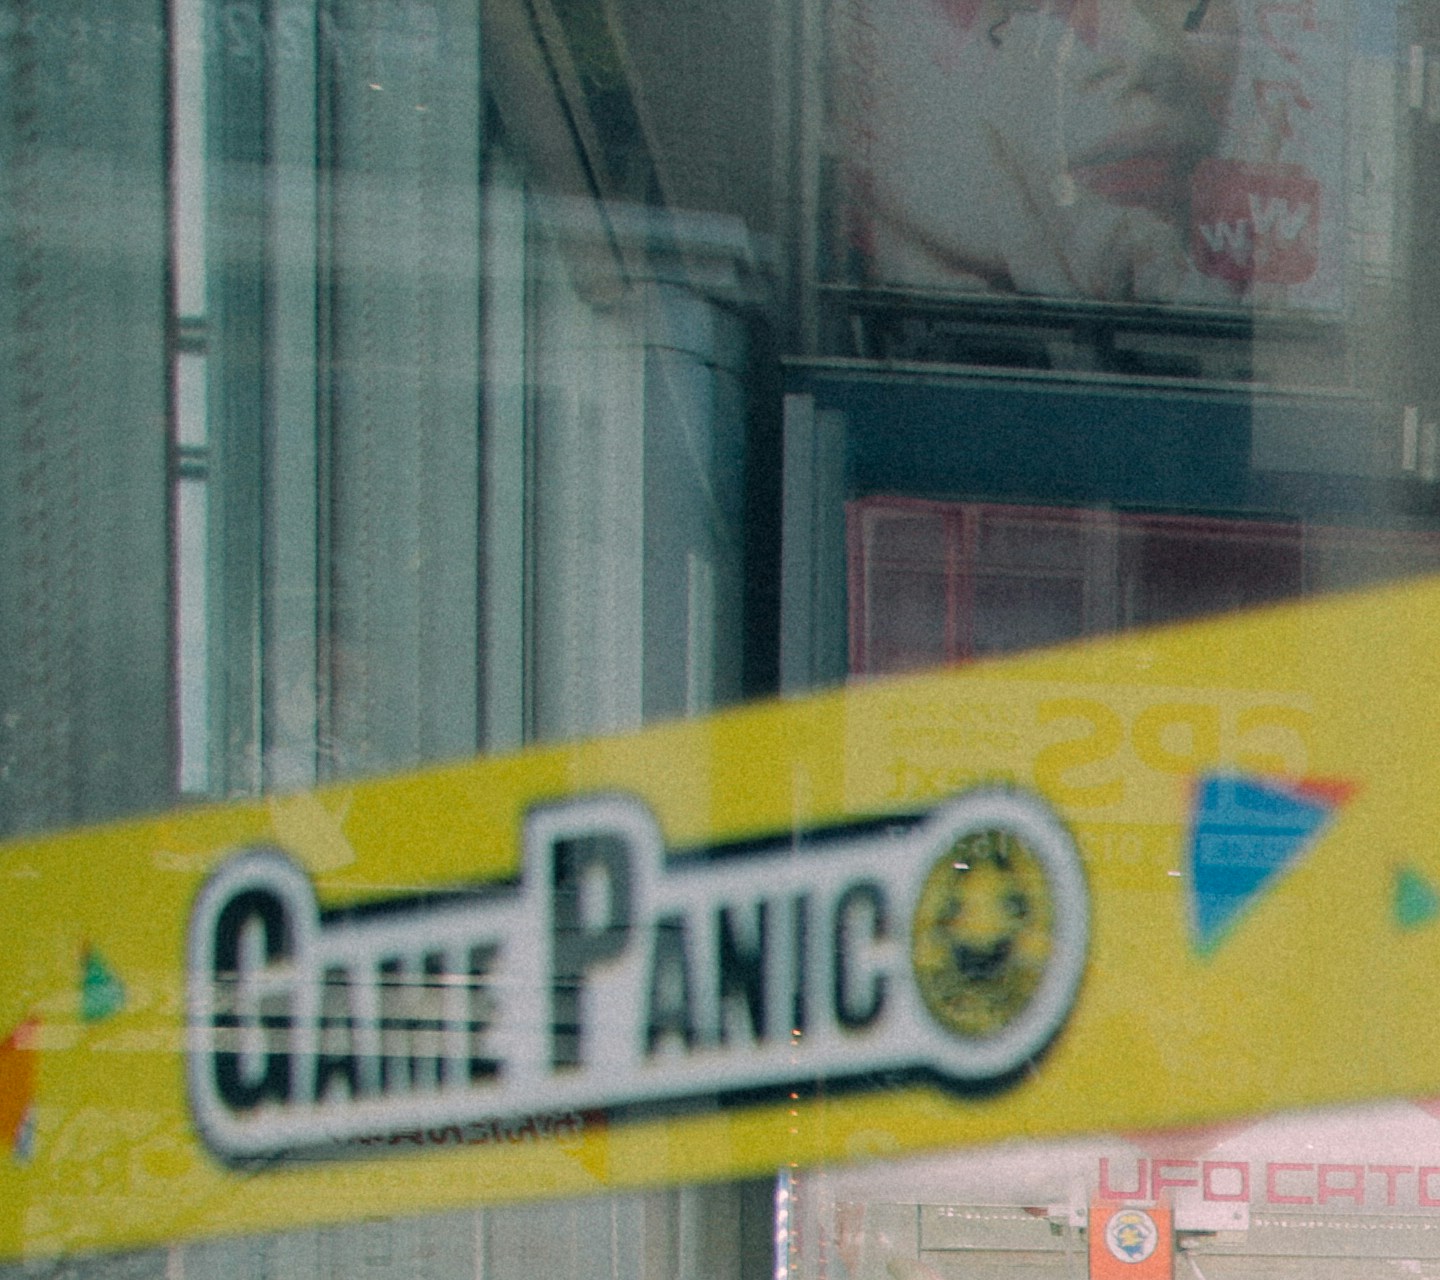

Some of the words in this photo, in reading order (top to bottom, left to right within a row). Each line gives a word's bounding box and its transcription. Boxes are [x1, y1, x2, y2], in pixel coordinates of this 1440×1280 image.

[211, 884, 500, 1112] GAME
[549, 835, 889, 1069] PANIC
[1099, 1157, 1250, 1202] UFO
